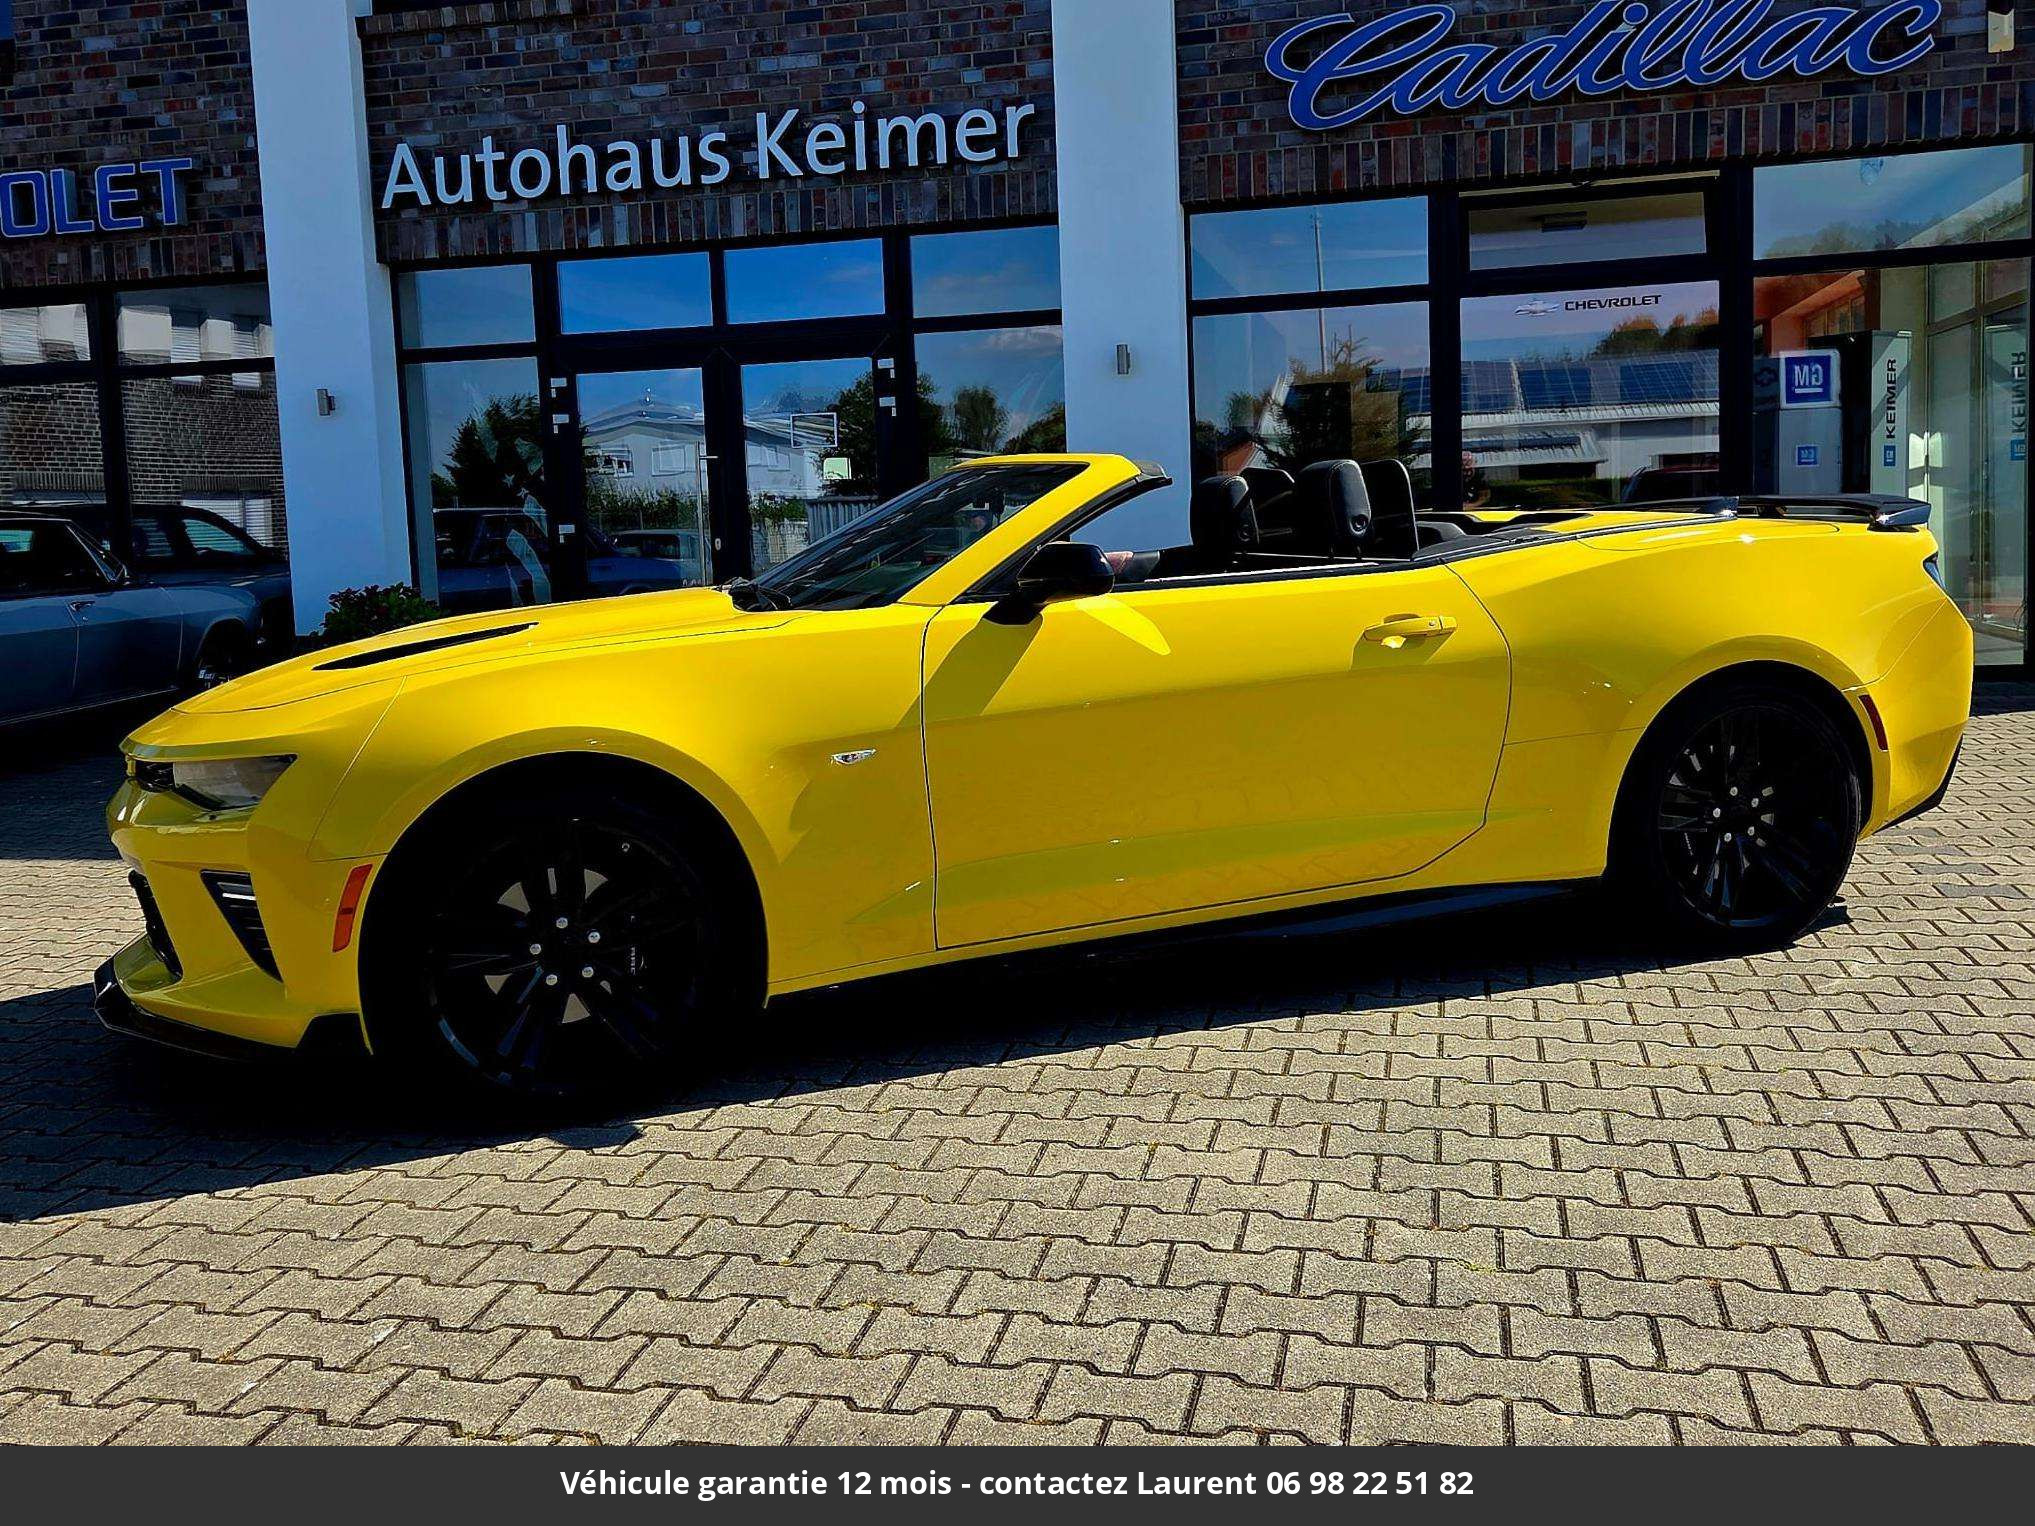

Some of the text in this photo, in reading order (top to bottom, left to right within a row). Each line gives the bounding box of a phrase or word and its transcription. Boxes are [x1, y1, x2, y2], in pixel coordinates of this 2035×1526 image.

[1265, 0, 1942, 131] Cadillac
[381, 100, 1035, 209] Autohaus Keimer
[0, 157, 193, 238] OLET
[1565, 295, 1662, 311] CHEVROLET
[1885, 358, 1897, 439] KEIMER
